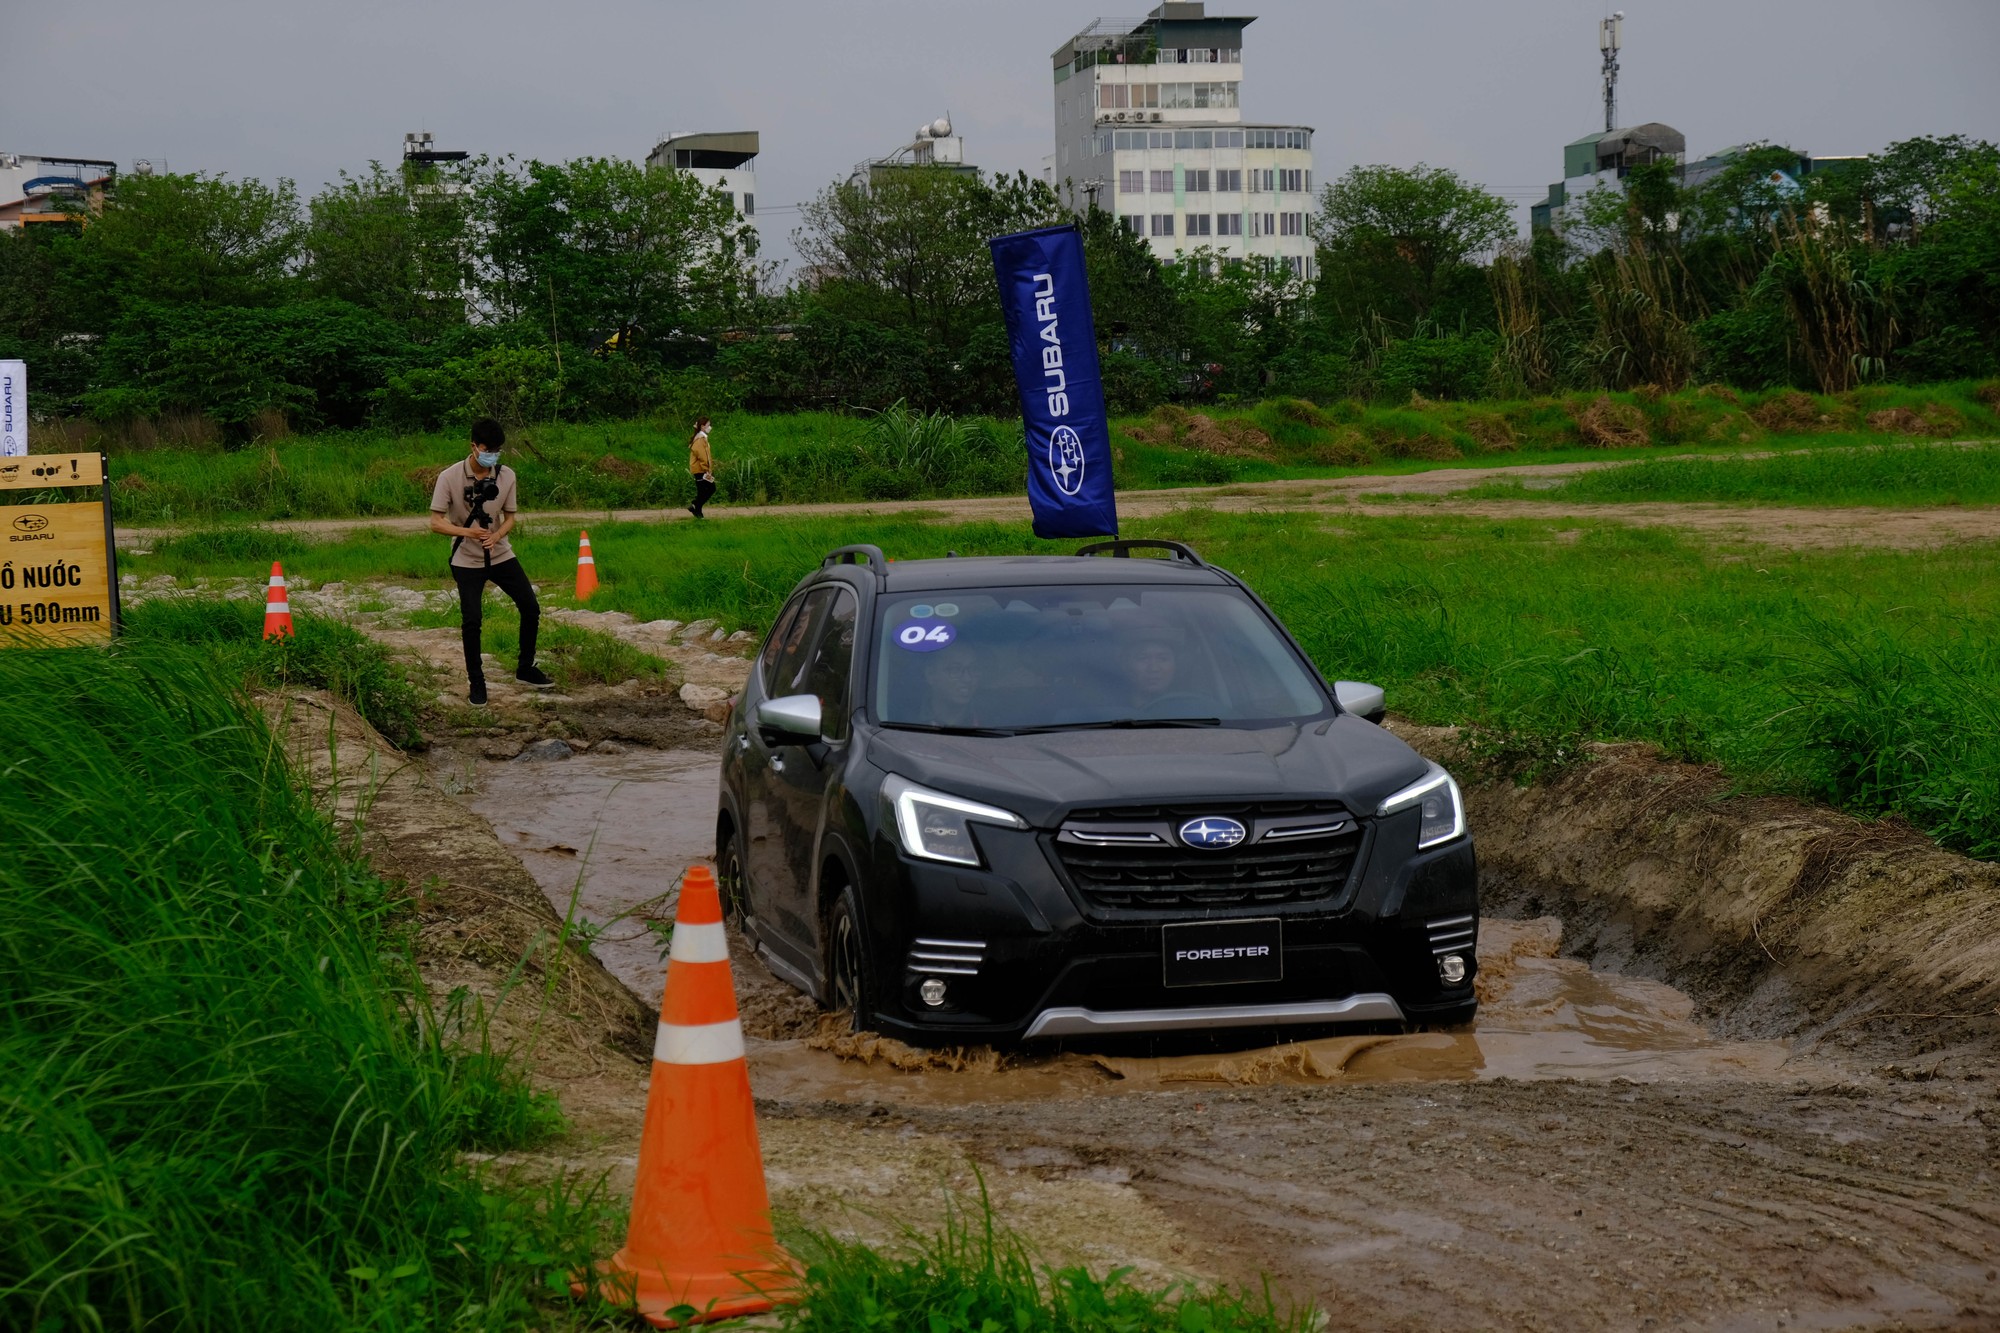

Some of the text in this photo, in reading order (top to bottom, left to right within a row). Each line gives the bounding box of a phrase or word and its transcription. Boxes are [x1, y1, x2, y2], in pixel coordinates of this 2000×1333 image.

[1033, 273, 1069, 417] SUBARU
[4, 376, 12, 432] SUBARU
[9, 533, 54, 542] SUBARU
[23, 559, 81, 588] NƯỚC
[21, 602, 100, 625] 500mm
[900, 625, 950, 644] 04
[1176, 946, 1270, 961] FORESTER
